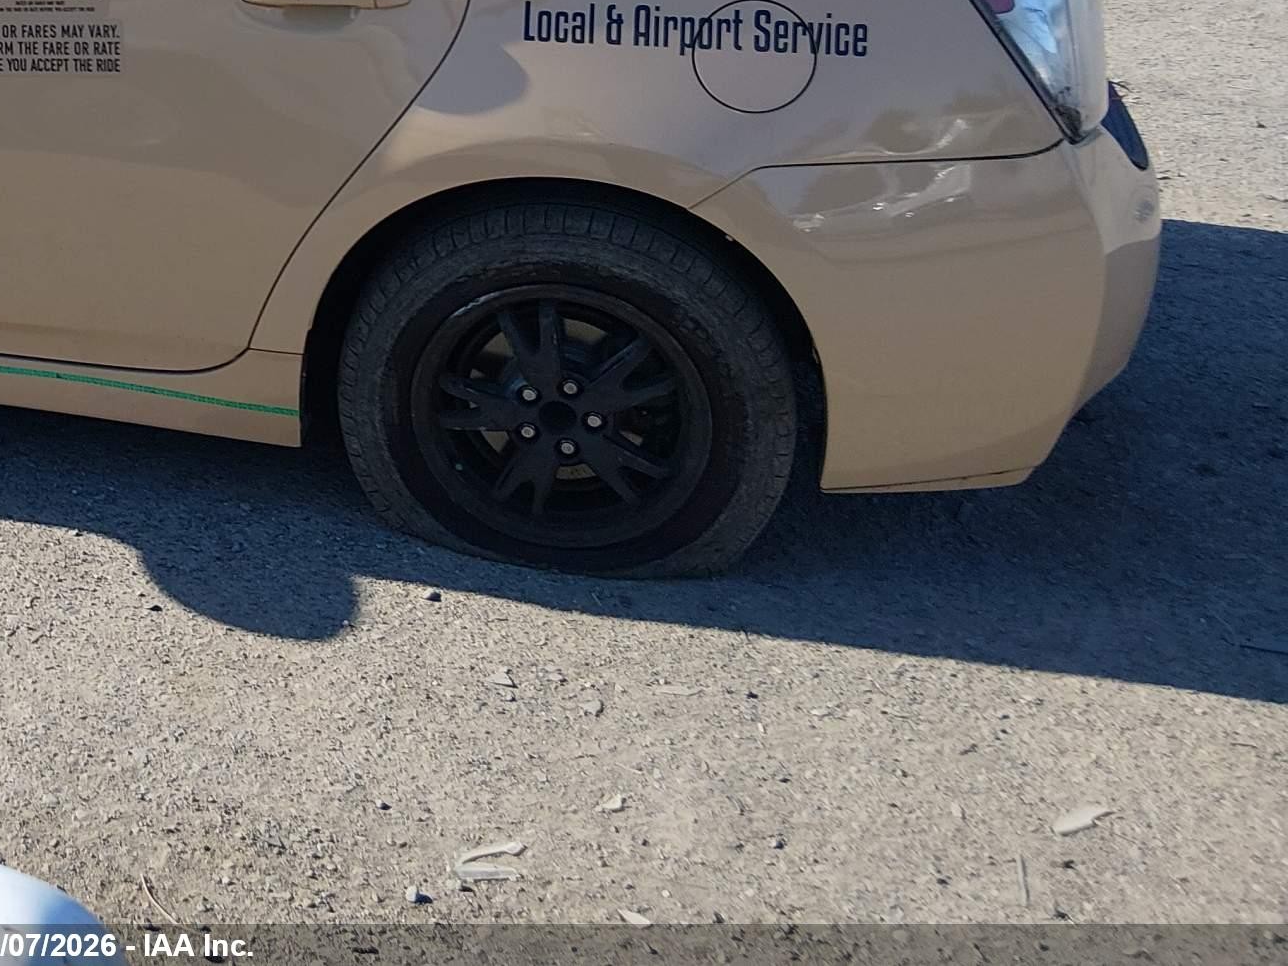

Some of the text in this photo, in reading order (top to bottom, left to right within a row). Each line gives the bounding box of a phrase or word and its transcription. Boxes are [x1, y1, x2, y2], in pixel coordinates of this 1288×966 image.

[2, 25, 17, 38] OR
[21, 25, 57, 38] FARES
[61, 25, 84, 38] MAY
[88, 25, 120, 38] VARY.
[523, 0, 868, 57] Local & Airport Service
[18, 41, 39, 55] THE
[43, 41, 69, 55] FARE
[74, 41, 89, 55] OR
[93, 41, 121, 55] RATE
[7, 58, 27, 72] YOU
[30, 58, 69, 72] ACCEPT
[73, 58, 93, 72] THE
[96, 58, 121, 72] RIDE
